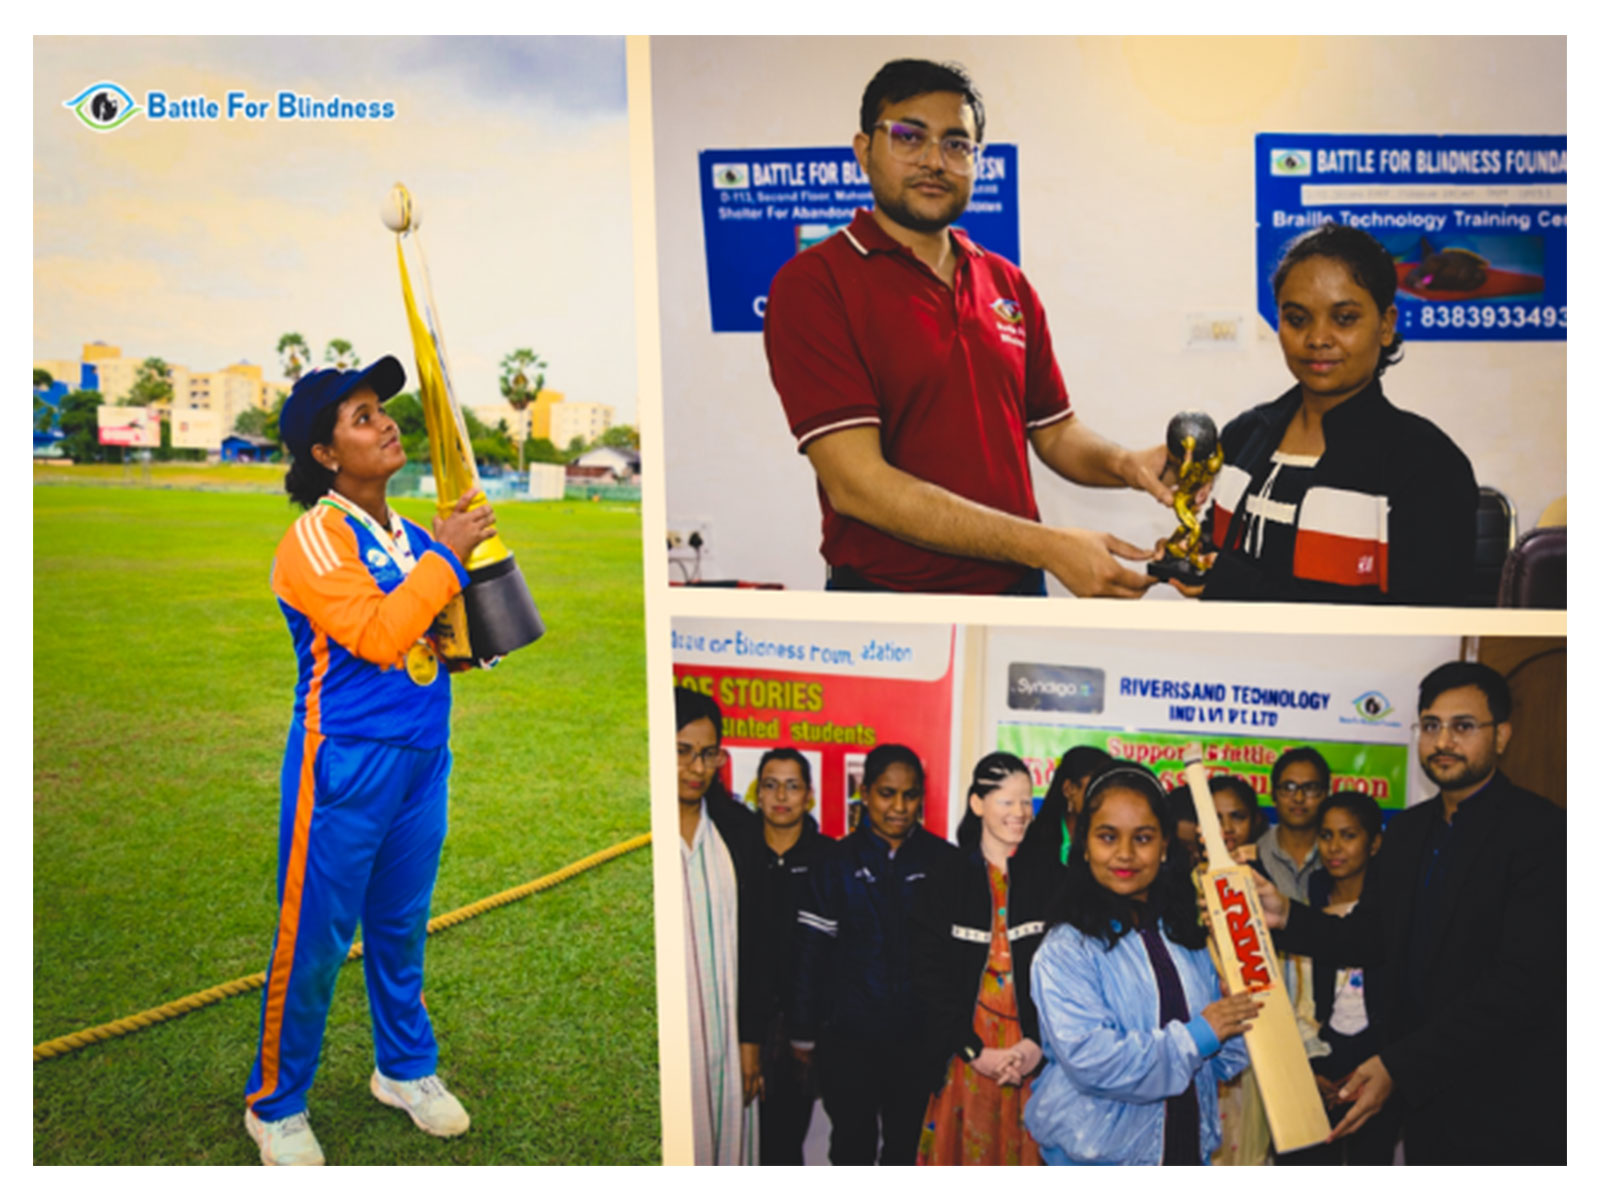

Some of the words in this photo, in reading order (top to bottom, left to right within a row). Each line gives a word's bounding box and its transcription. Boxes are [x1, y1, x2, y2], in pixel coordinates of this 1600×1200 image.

[752, 162, 806, 187] BATTLE
[809, 160, 839, 186] FOR
[1316, 149, 1374, 173] BATTLE
[1380, 149, 1412, 173] FOR
[766, 205, 789, 219] For
[1339, 210, 1447, 231] Technology
[1453, 210, 1531, 231] Training
[719, 678, 824, 712] STORIES
[790, 720, 876, 746] students
